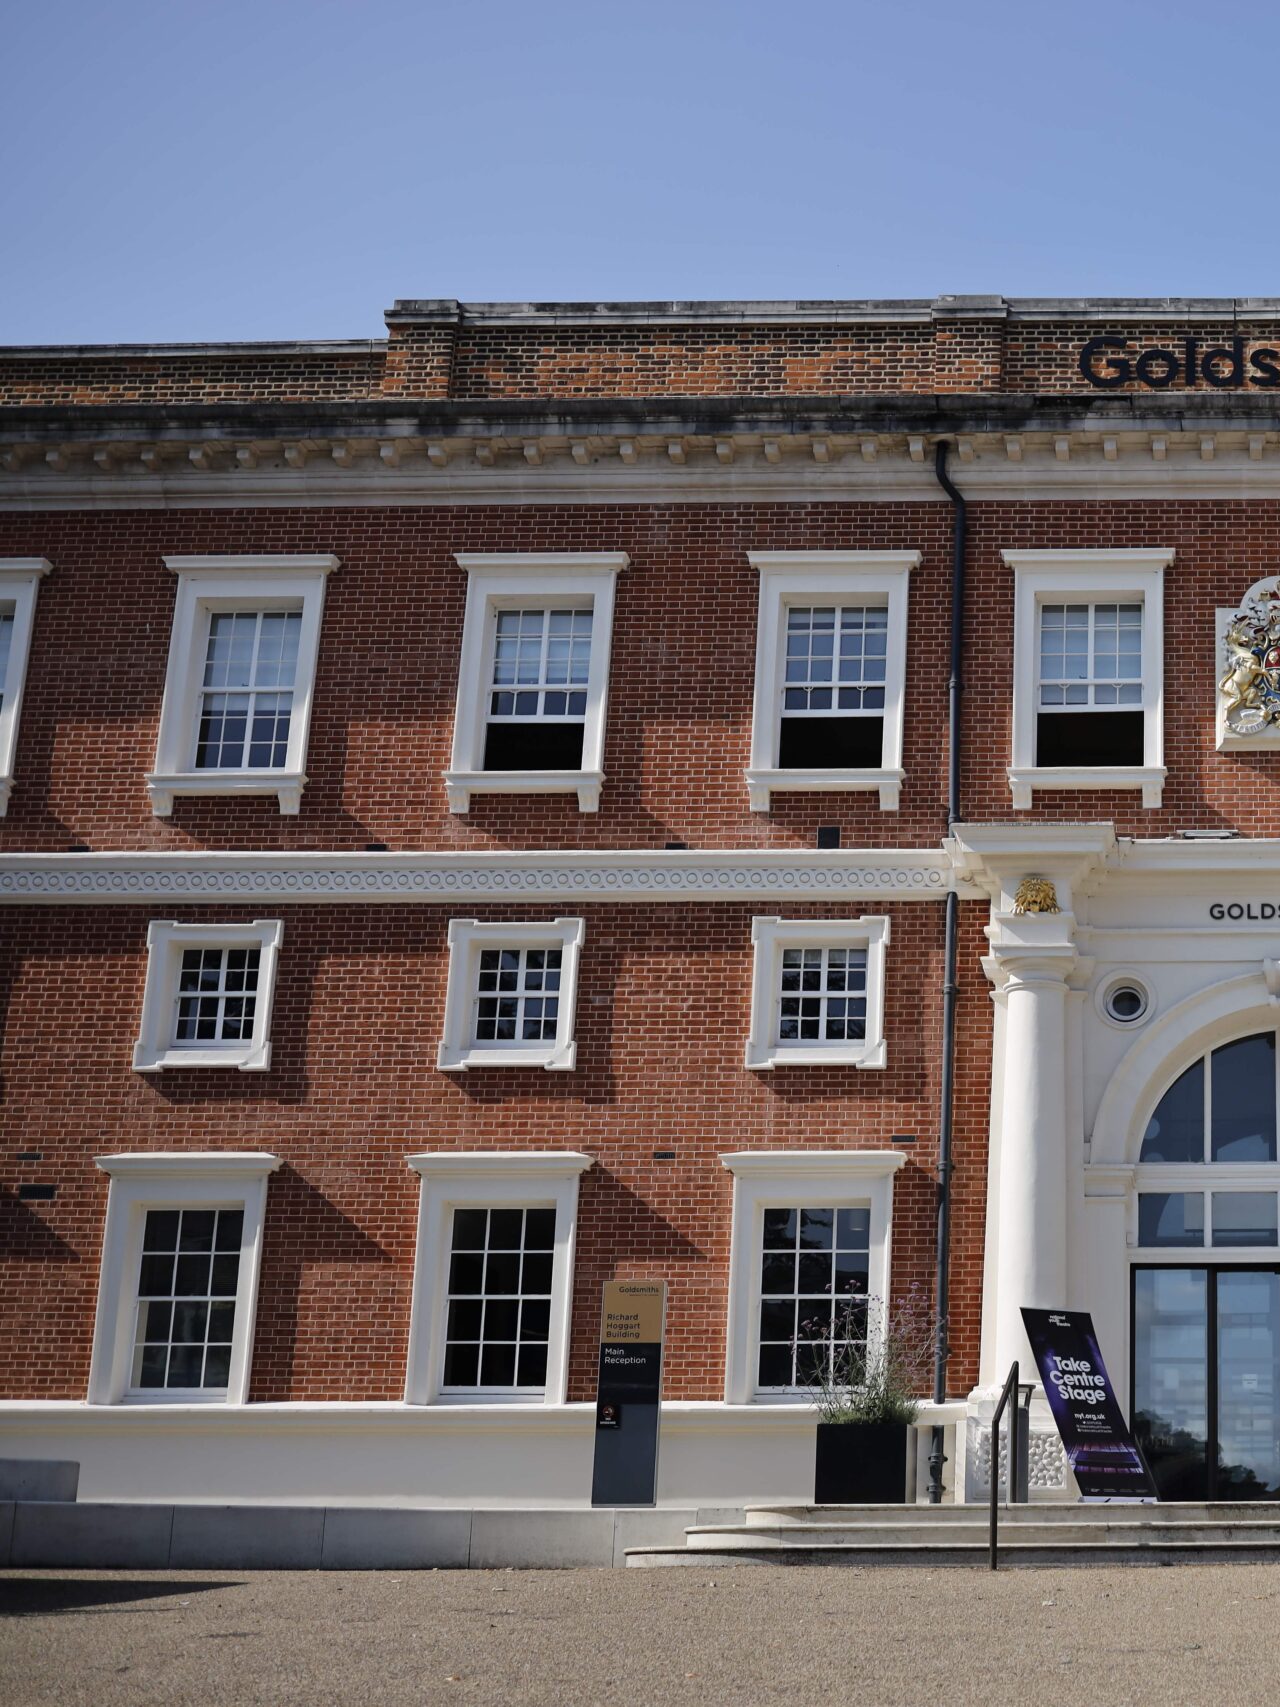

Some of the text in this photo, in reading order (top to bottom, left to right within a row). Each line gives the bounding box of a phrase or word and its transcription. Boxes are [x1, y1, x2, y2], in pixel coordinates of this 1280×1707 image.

[619, 1286, 659, 1294] Goldsmiths
[607, 1313, 639, 1321] Richard
[606, 1322, 641, 1330] Hoggart
[606, 1330, 641, 1339] Building
[604, 1356, 647, 1365] Reception
[1052, 1356, 1091, 1373] Take
[1049, 1371, 1105, 1387] Centre
[1058, 1385, 1106, 1405] Stage
